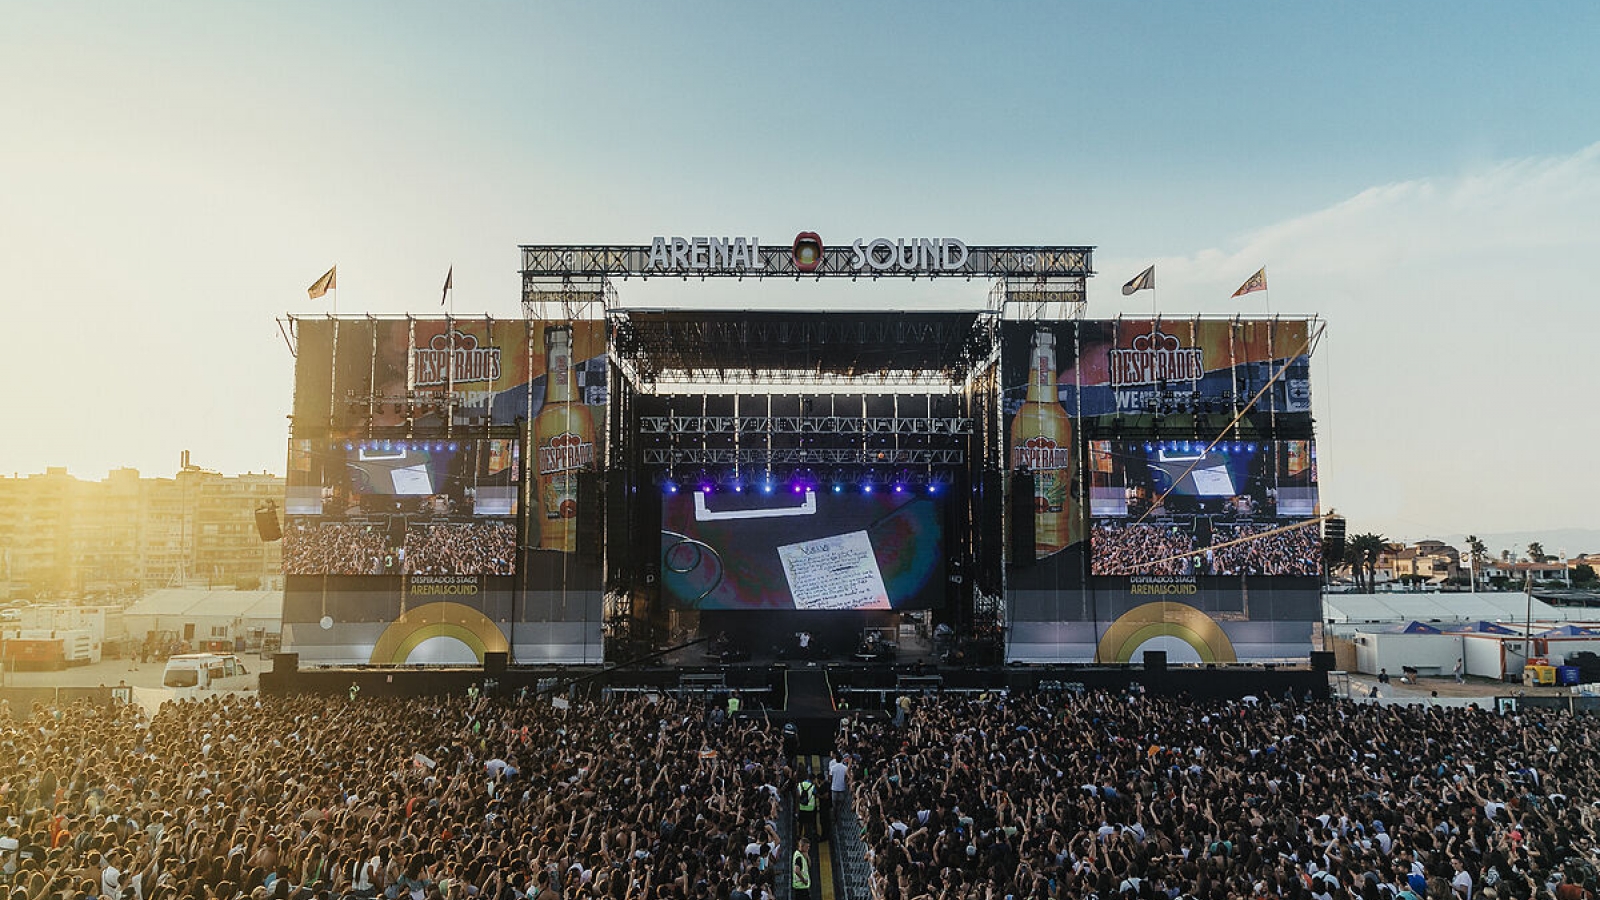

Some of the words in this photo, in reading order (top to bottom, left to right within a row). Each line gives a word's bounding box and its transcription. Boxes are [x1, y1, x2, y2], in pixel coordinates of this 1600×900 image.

[648, 236, 765, 269] ARENAL
[852, 237, 969, 270] SOUND
[1114, 391, 1140, 409] WE
[411, 585, 478, 594] ARENALSOUND
[1130, 584, 1196, 594] ARENALSOUND
